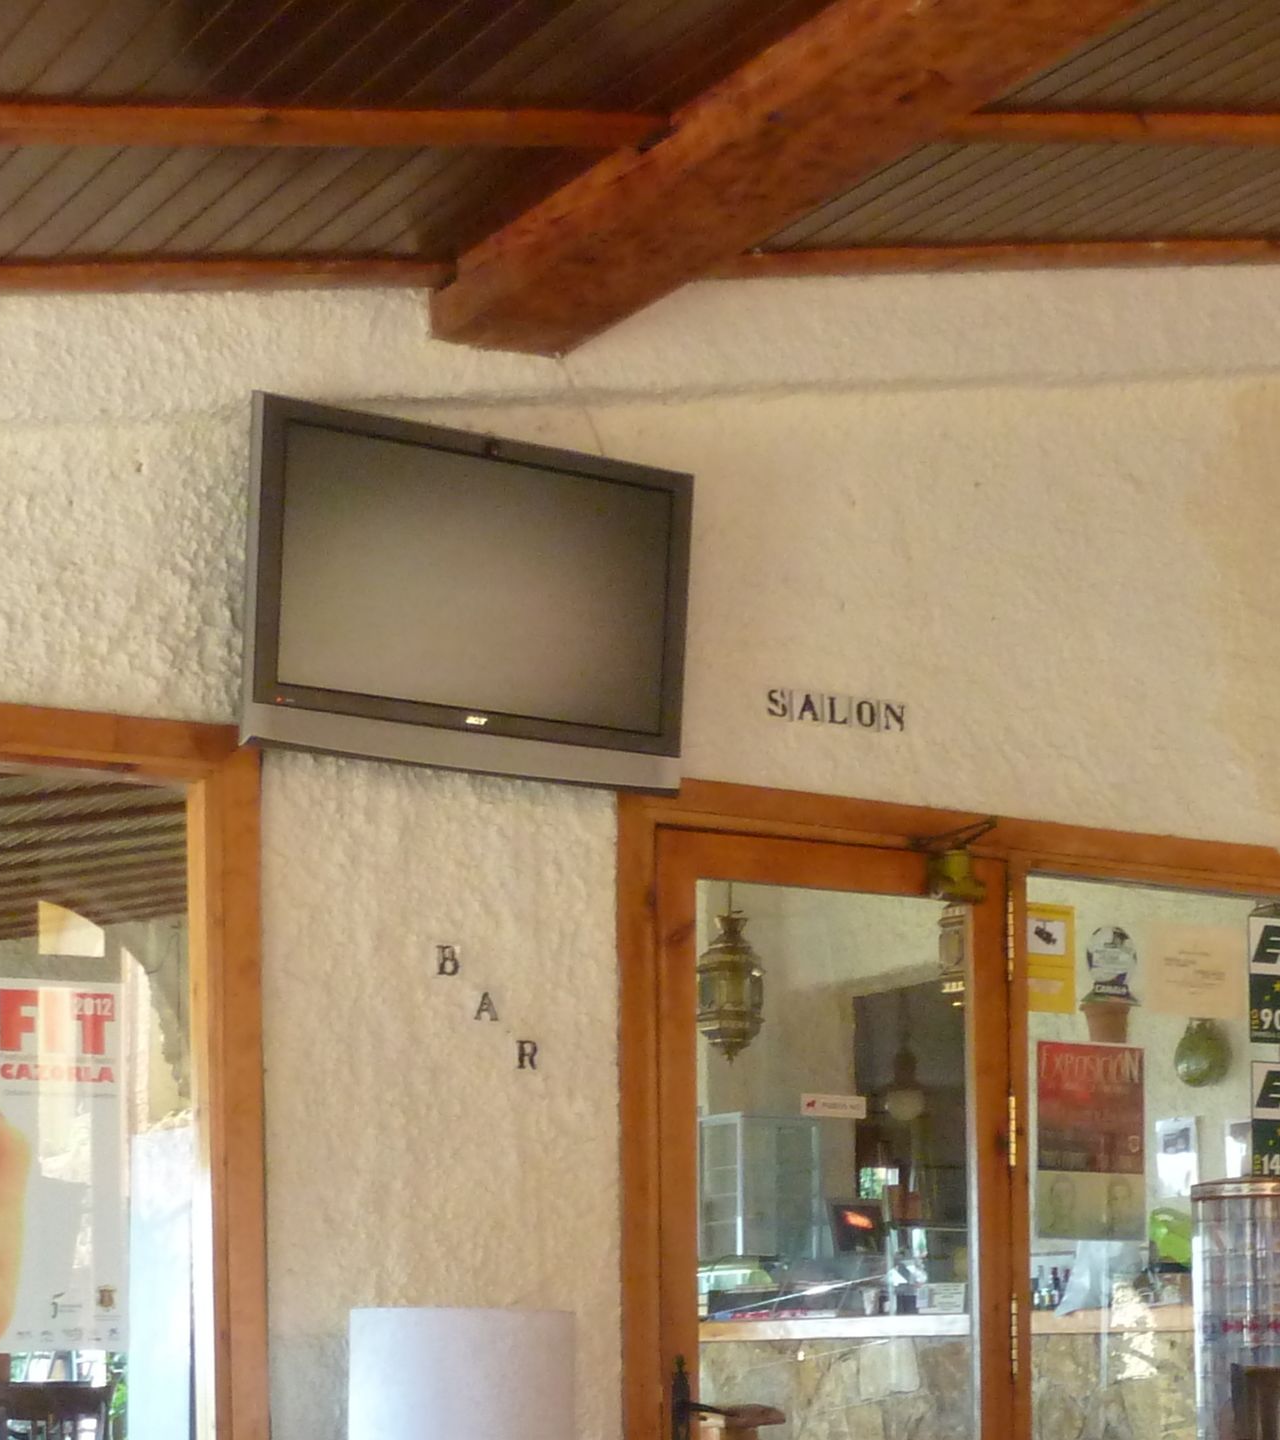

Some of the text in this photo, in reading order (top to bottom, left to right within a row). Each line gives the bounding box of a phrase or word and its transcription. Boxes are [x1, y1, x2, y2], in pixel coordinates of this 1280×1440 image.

[767, 688, 906, 732] SALON
[73, 997, 113, 1016] 2012
[436, 944, 539, 1070] BAR
[0, 1063, 115, 1083] CAZORLA
